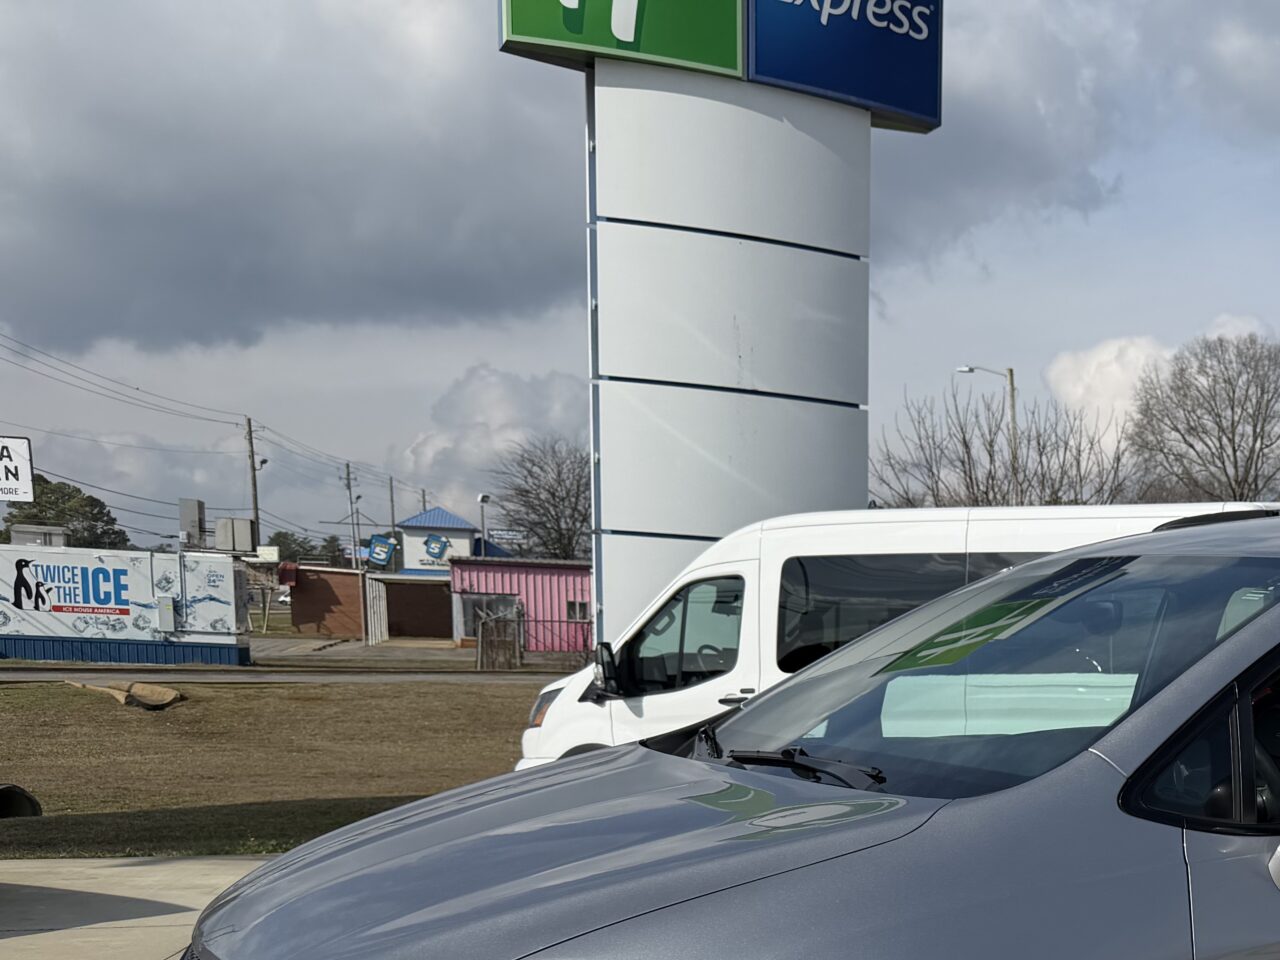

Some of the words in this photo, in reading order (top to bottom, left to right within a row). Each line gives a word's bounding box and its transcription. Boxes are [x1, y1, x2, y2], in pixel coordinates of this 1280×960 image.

[778, 0, 930, 40] press
[33, 564, 79, 584] TWICE
[81, 567, 130, 606] ICE
[55, 585, 80, 604] THE
